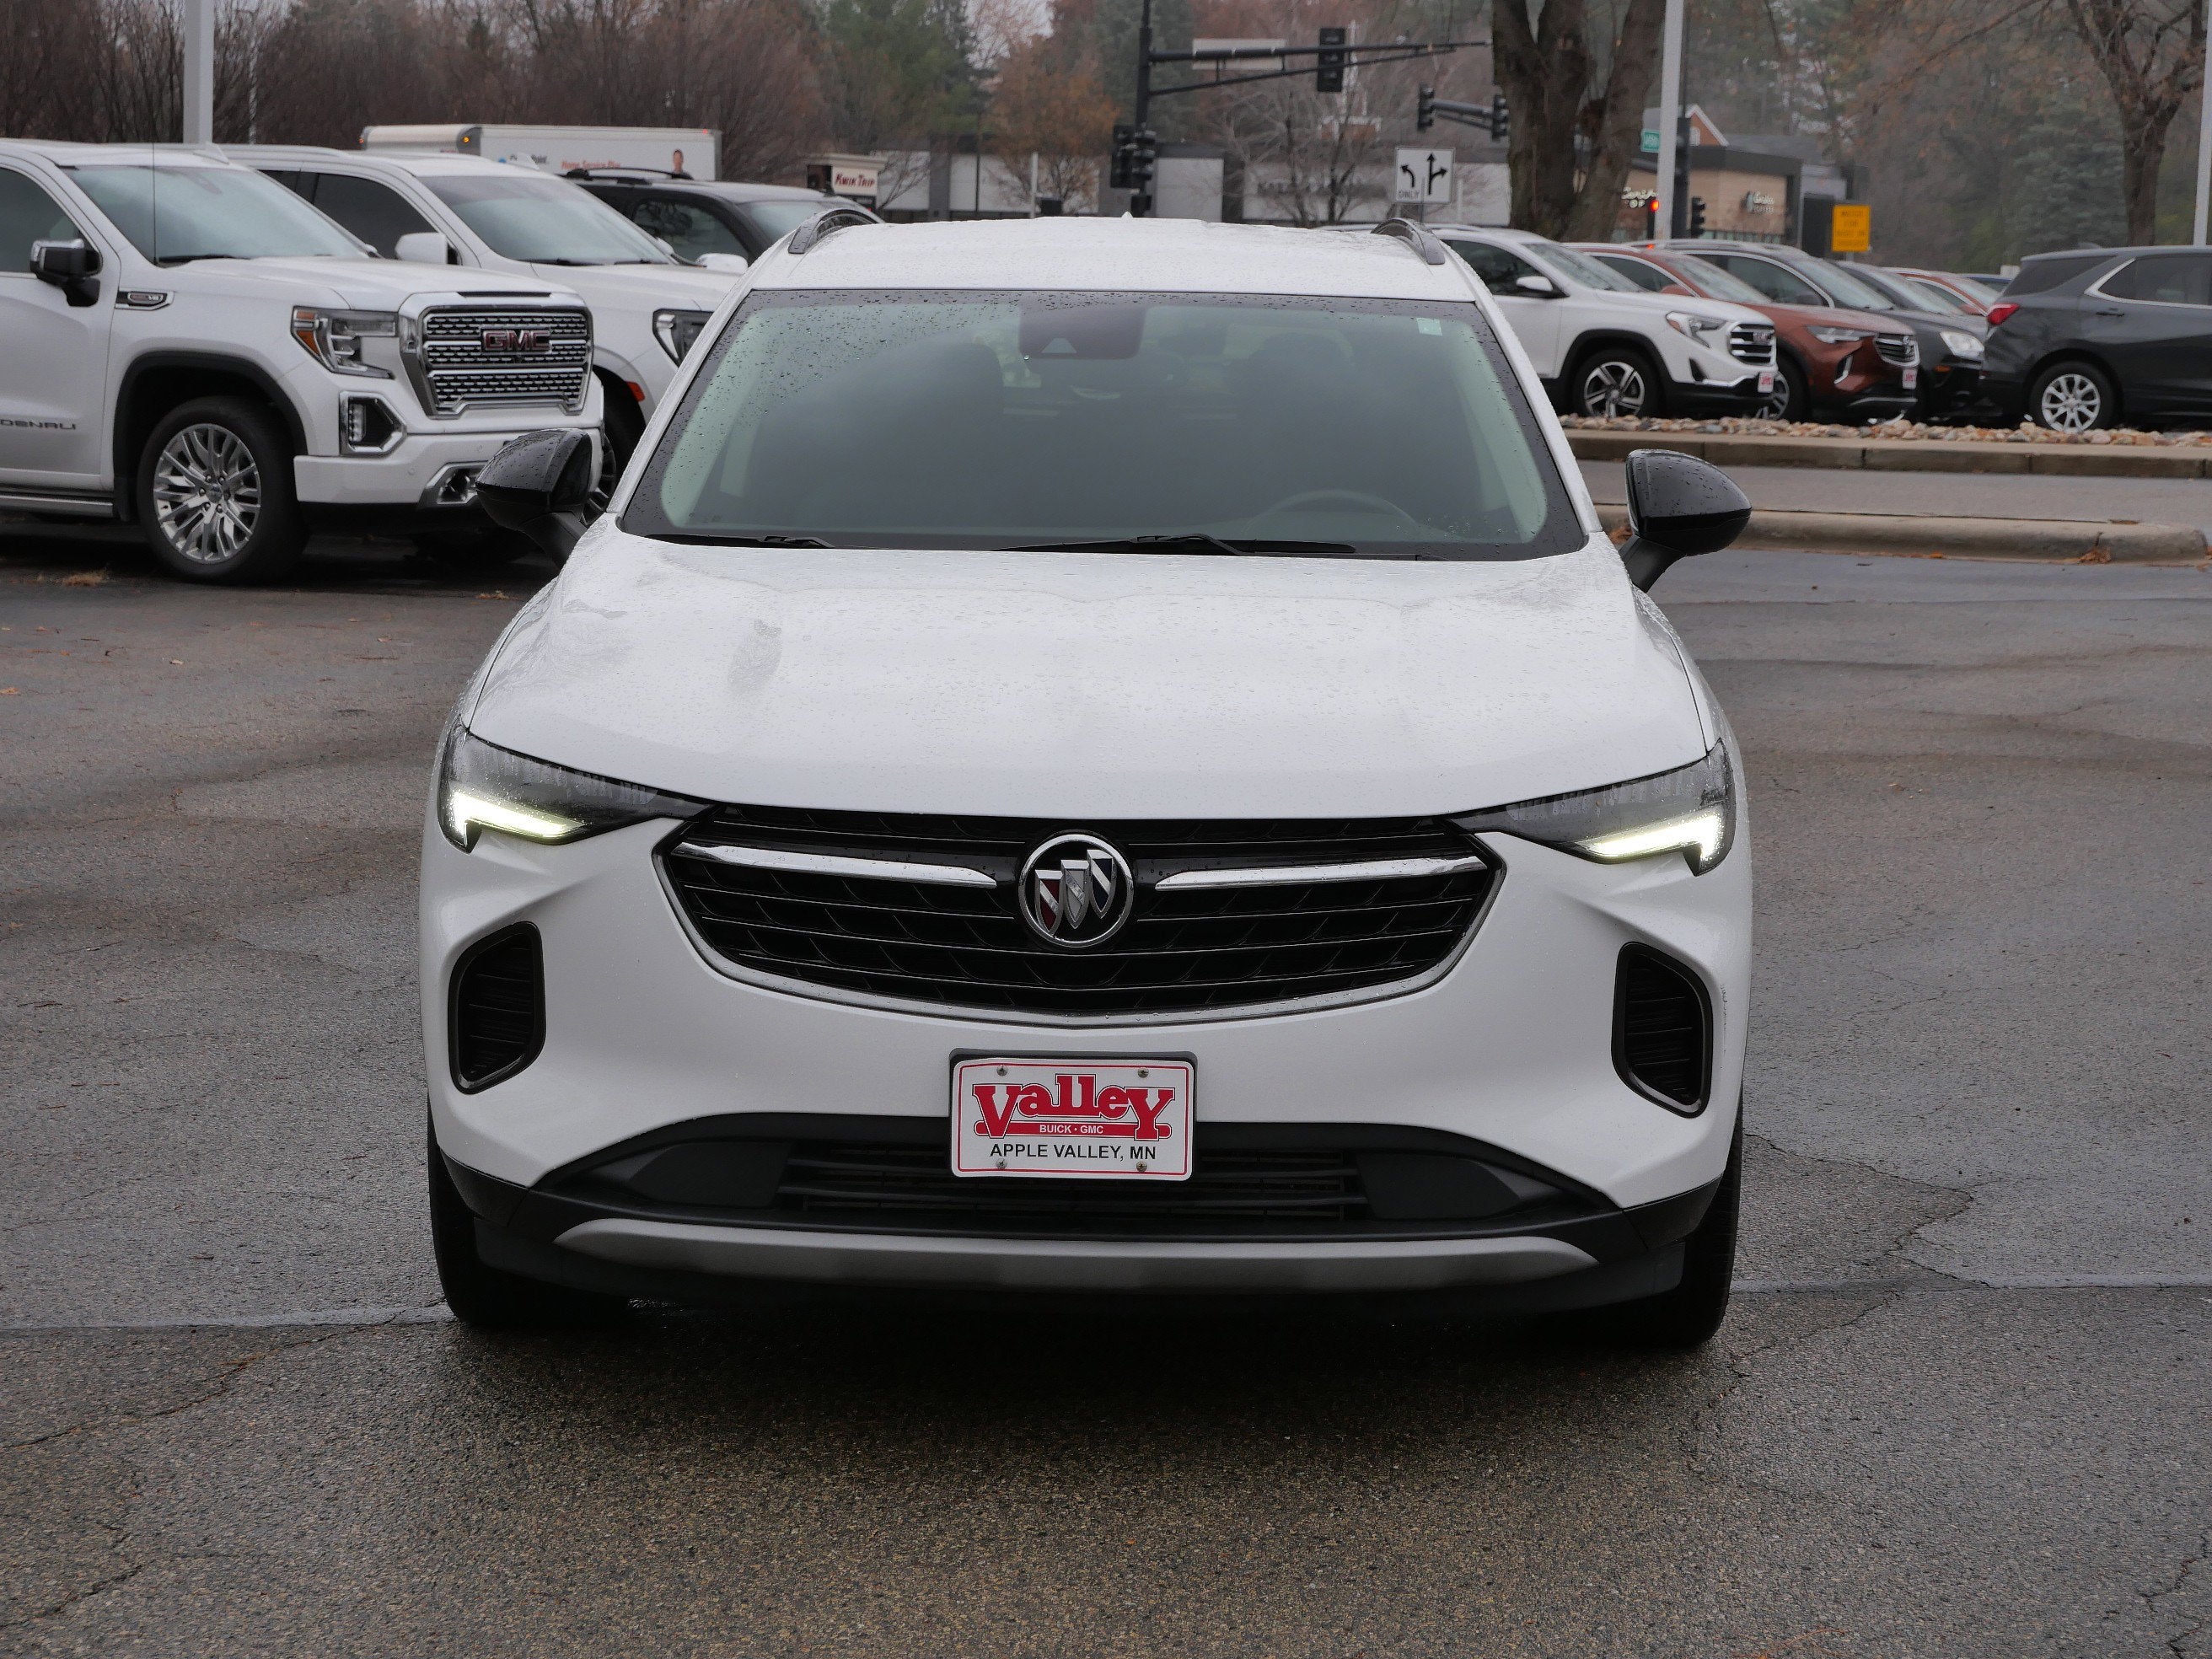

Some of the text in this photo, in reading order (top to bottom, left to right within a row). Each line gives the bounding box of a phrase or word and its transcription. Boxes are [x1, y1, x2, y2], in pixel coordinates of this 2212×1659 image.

[1398, 190, 1420, 200] ONLY
[483, 330, 550, 351] GMC
[0, 419, 77, 430] DENALI
[1039, 1125, 1104, 1135] BUICK GMC
[990, 1143, 1157, 1162] APPLE VALLEY, MN
